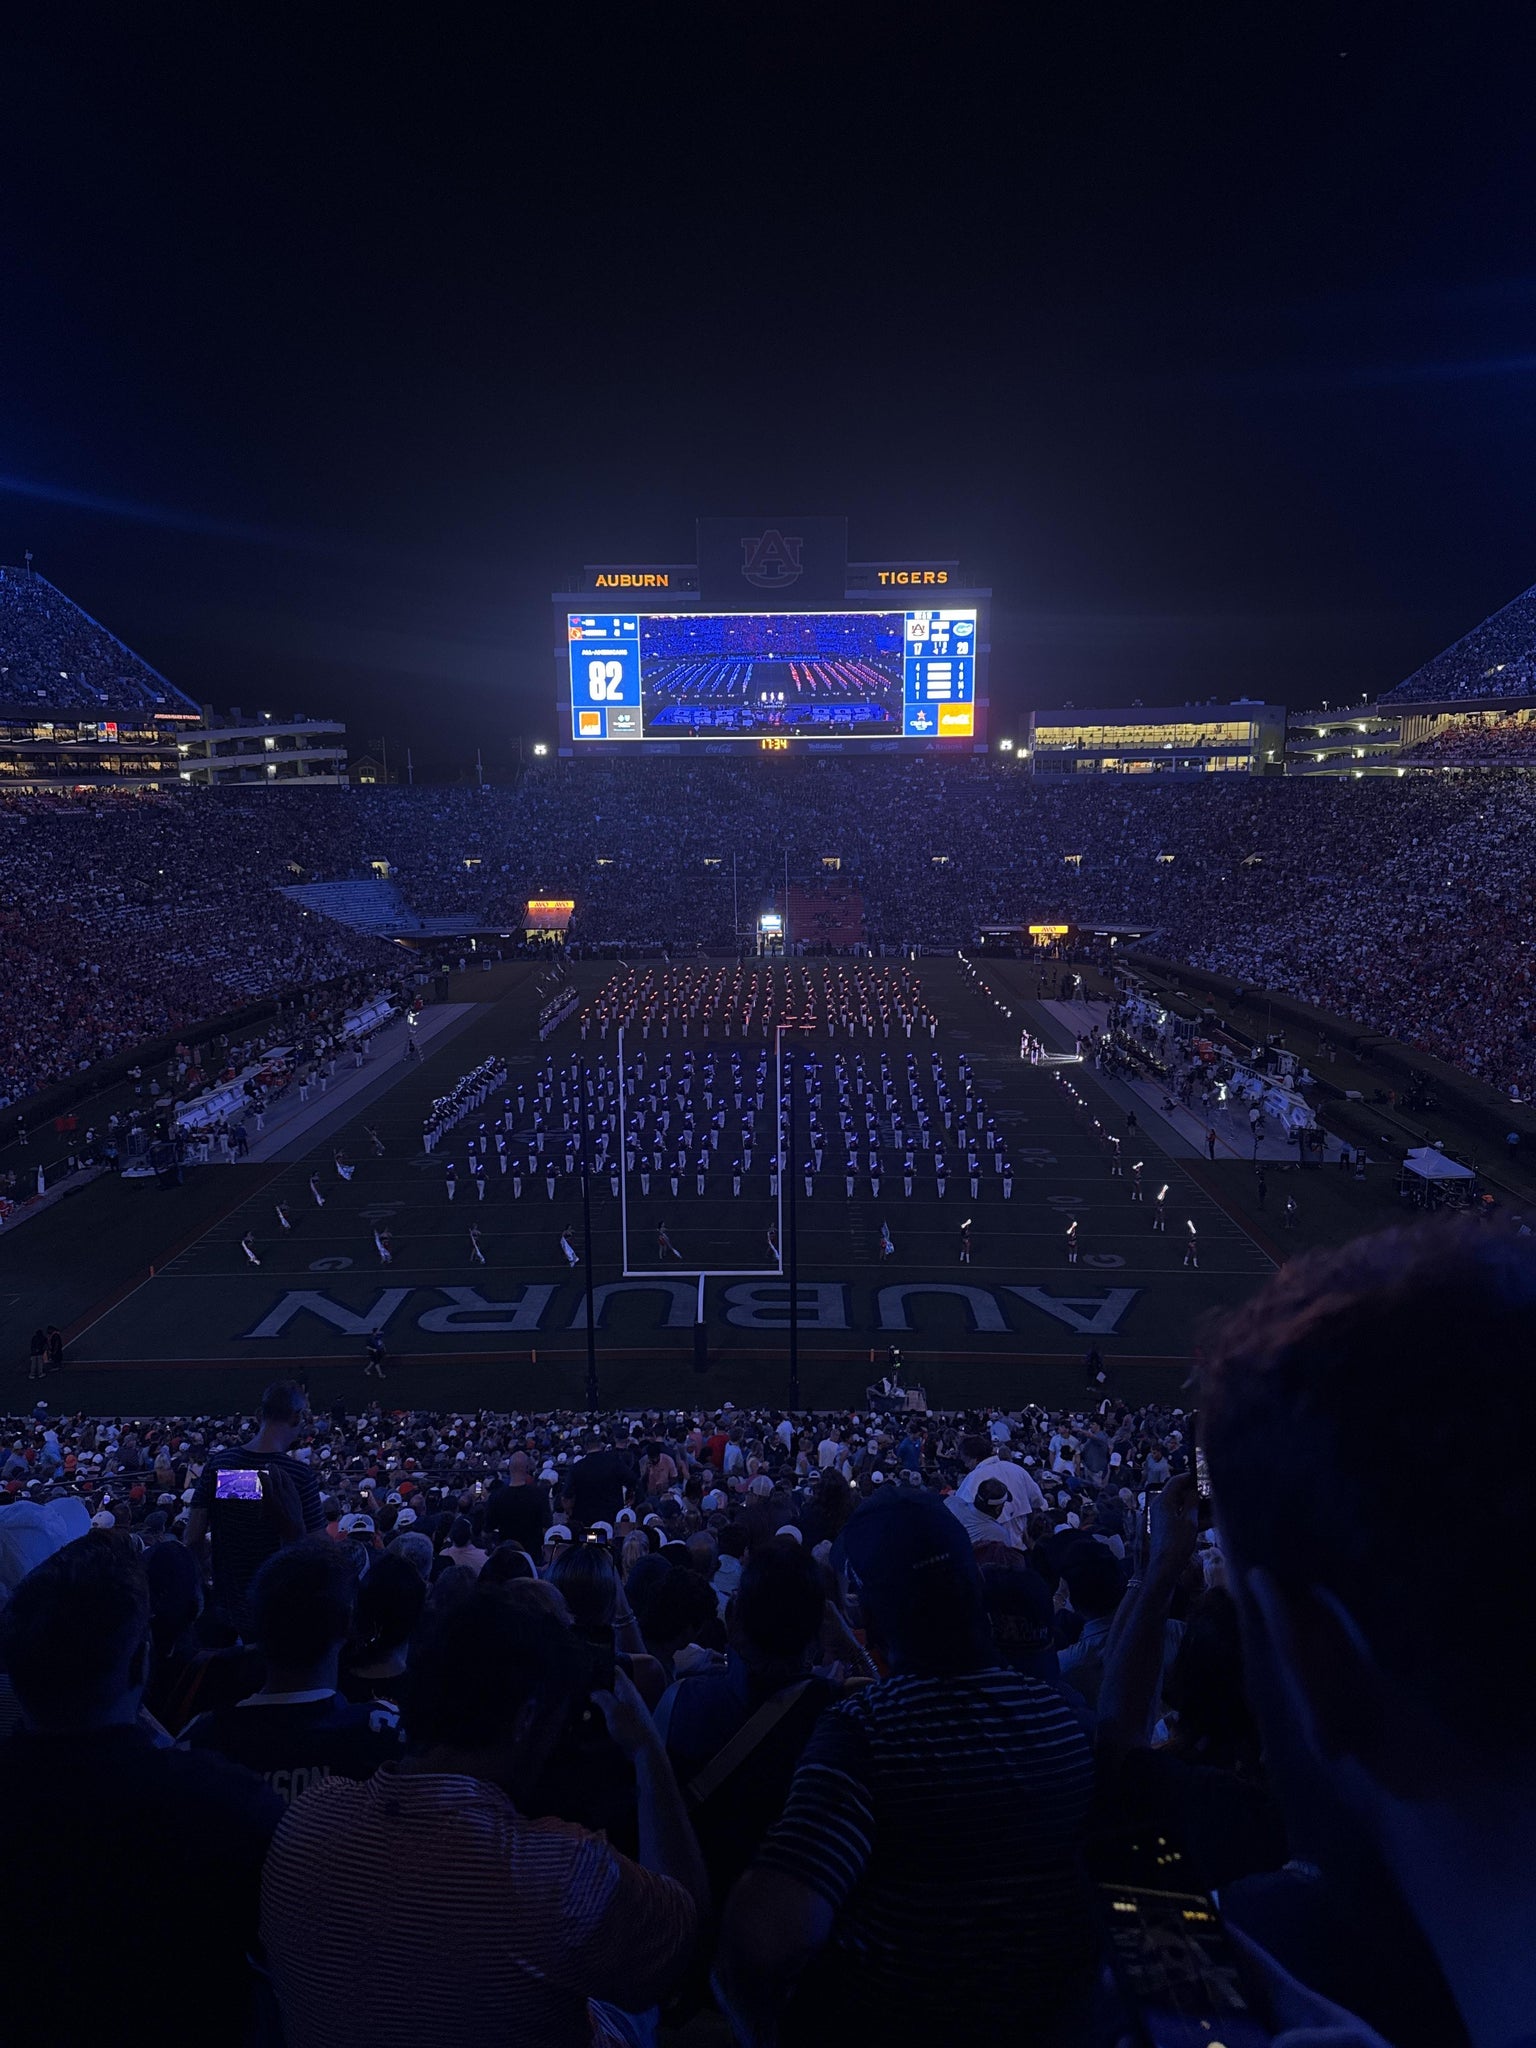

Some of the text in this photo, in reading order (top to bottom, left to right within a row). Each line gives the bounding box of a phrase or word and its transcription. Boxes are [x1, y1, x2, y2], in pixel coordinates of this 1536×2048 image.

[595, 574, 670, 588] AUBURN
[877, 571, 949, 586] TIGERS
[588, 660, 624, 701] 82
[762, 738, 787, 749] 17:34
[243, 1283, 1144, 1338] AUBURN
